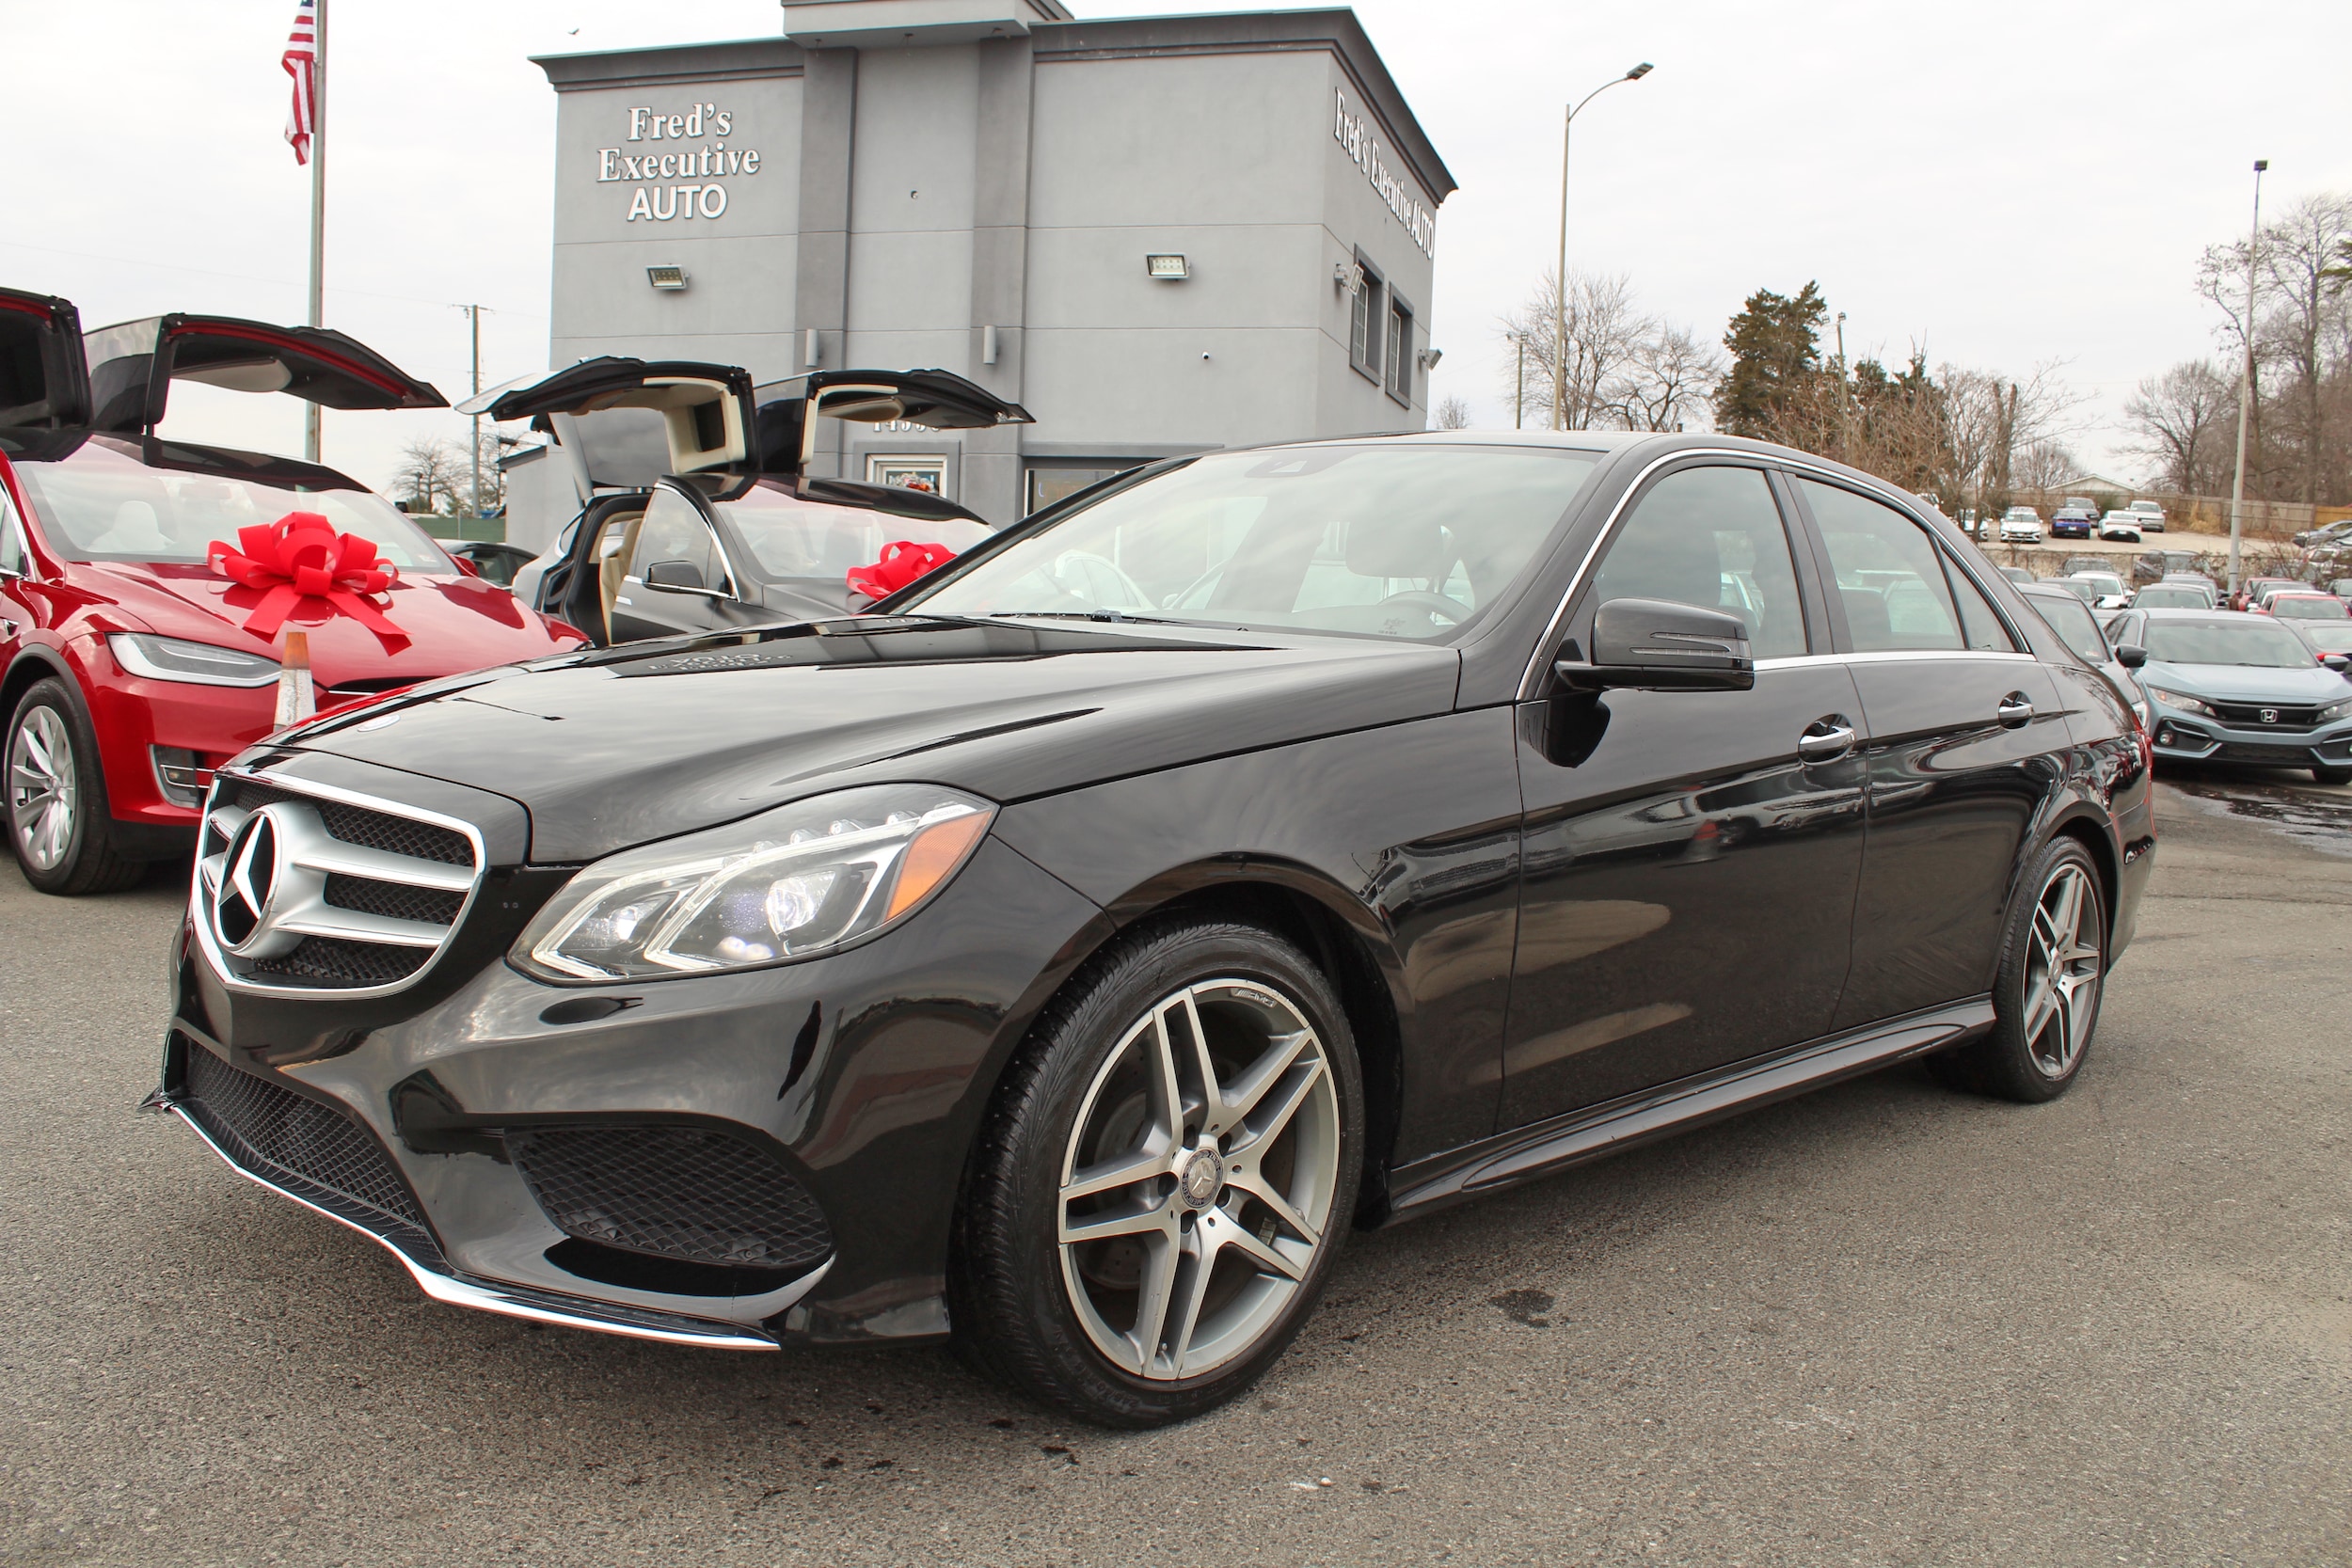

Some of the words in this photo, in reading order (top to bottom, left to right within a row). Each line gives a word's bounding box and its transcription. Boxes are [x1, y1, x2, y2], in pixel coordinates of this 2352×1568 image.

[627, 103, 733, 141] Fred's
[596, 142, 760, 182] Executive
[1334, 87, 1368, 174] Fred's
[1370, 136, 1411, 231] Executive
[1411, 198, 1435, 260] AUTO
[627, 182, 728, 222] AUTO
